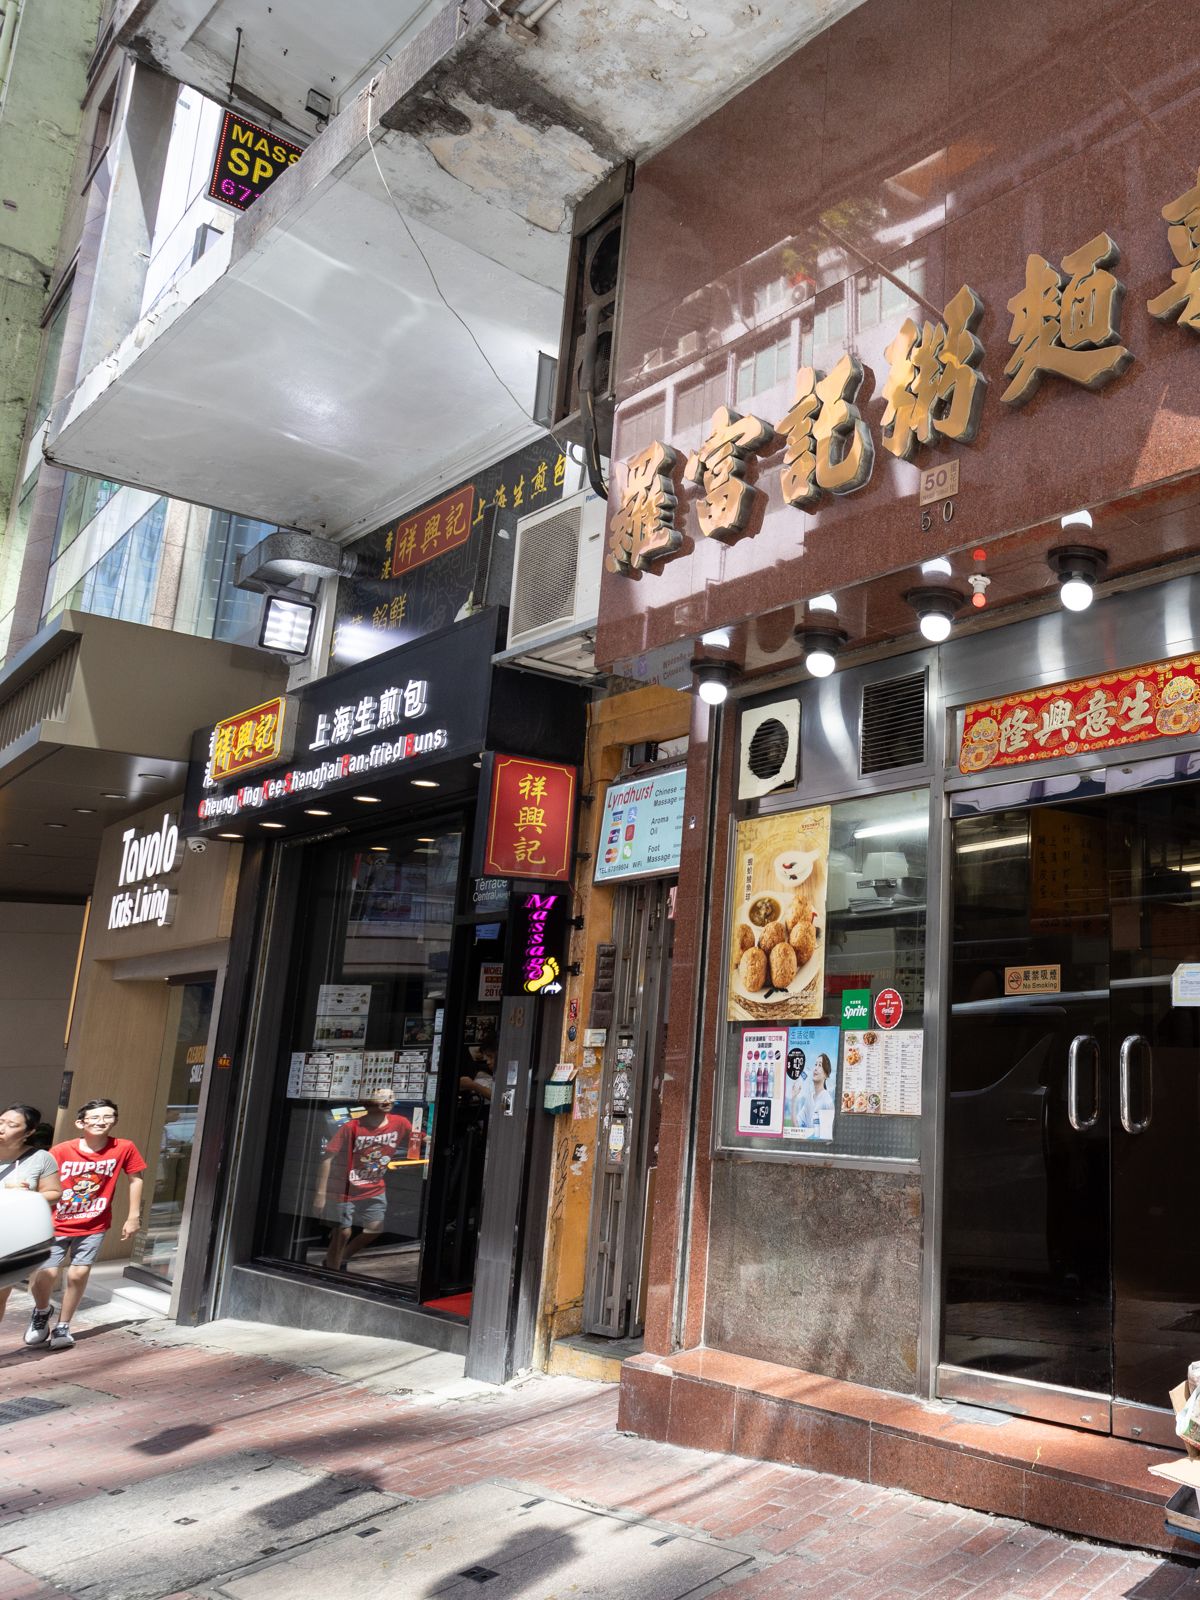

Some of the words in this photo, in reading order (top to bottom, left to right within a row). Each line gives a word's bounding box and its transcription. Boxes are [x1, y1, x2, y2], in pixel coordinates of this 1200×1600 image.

[221, 178, 260, 202] 67
[924, 469, 948, 491] 50
[399, 502, 466, 565] 祥興記
[309, 680, 427, 750] 上海生煎包
[215, 713, 277, 770] 祥興記
[198, 795, 238, 819] Cheung
[238, 786, 263, 808] Hing
[263, 778, 284, 800] Kee
[284, 756, 342, 794] Shanghai
[404, 729, 447, 758] Buns
[608, 782, 654, 811] Lyndhurst
[653, 797, 678, 807] Massage
[655, 786, 677, 797] Chinese
[513, 773, 549, 865] 祥興記
[650, 816, 669, 826] Aroma
[108, 892, 134, 930] Kids
[132, 883, 170, 927] Living
[1032, 981, 1057, 989] Smoking
[844, 1004, 868, 1019] Sprite
[60, 1159, 117, 1182] SUPER
